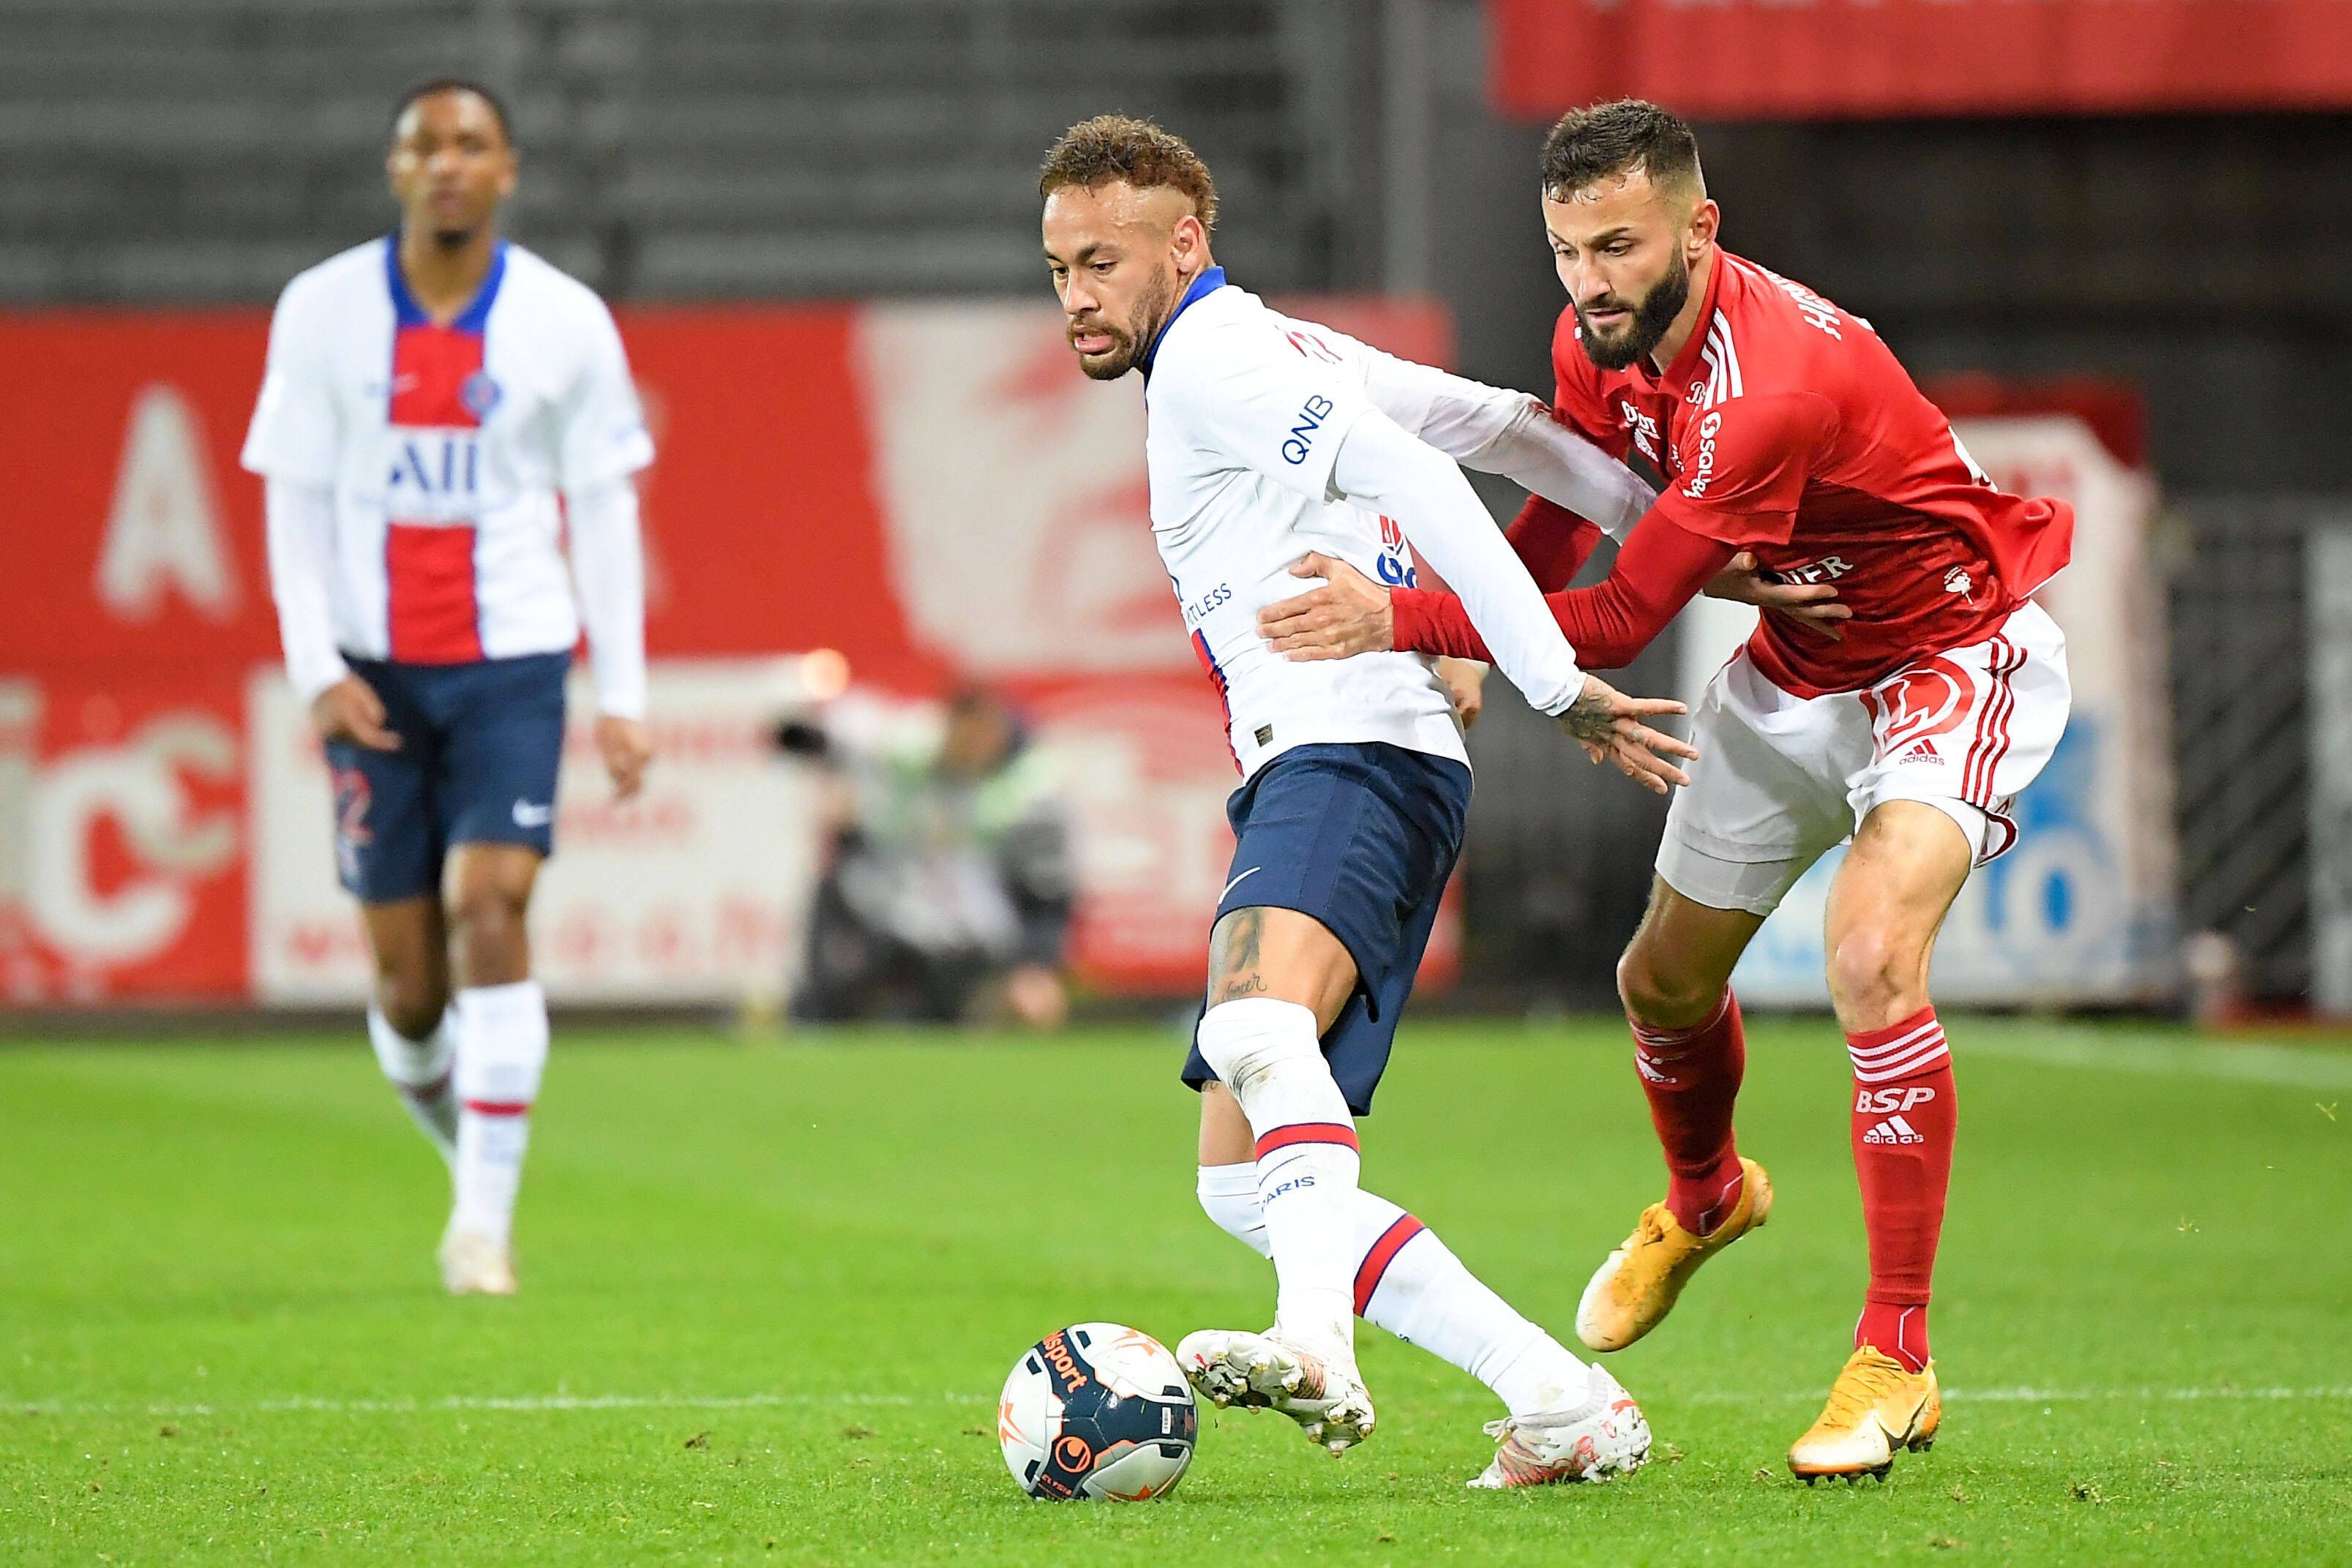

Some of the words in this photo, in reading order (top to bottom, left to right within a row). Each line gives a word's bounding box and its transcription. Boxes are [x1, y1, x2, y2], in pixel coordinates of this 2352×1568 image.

[1282, 395, 1333, 465] QNB
[1899, 754, 1945, 766] adidas
[1855, 1087, 1936, 1114] BSP
[1863, 1134, 1925, 1144] adidas
